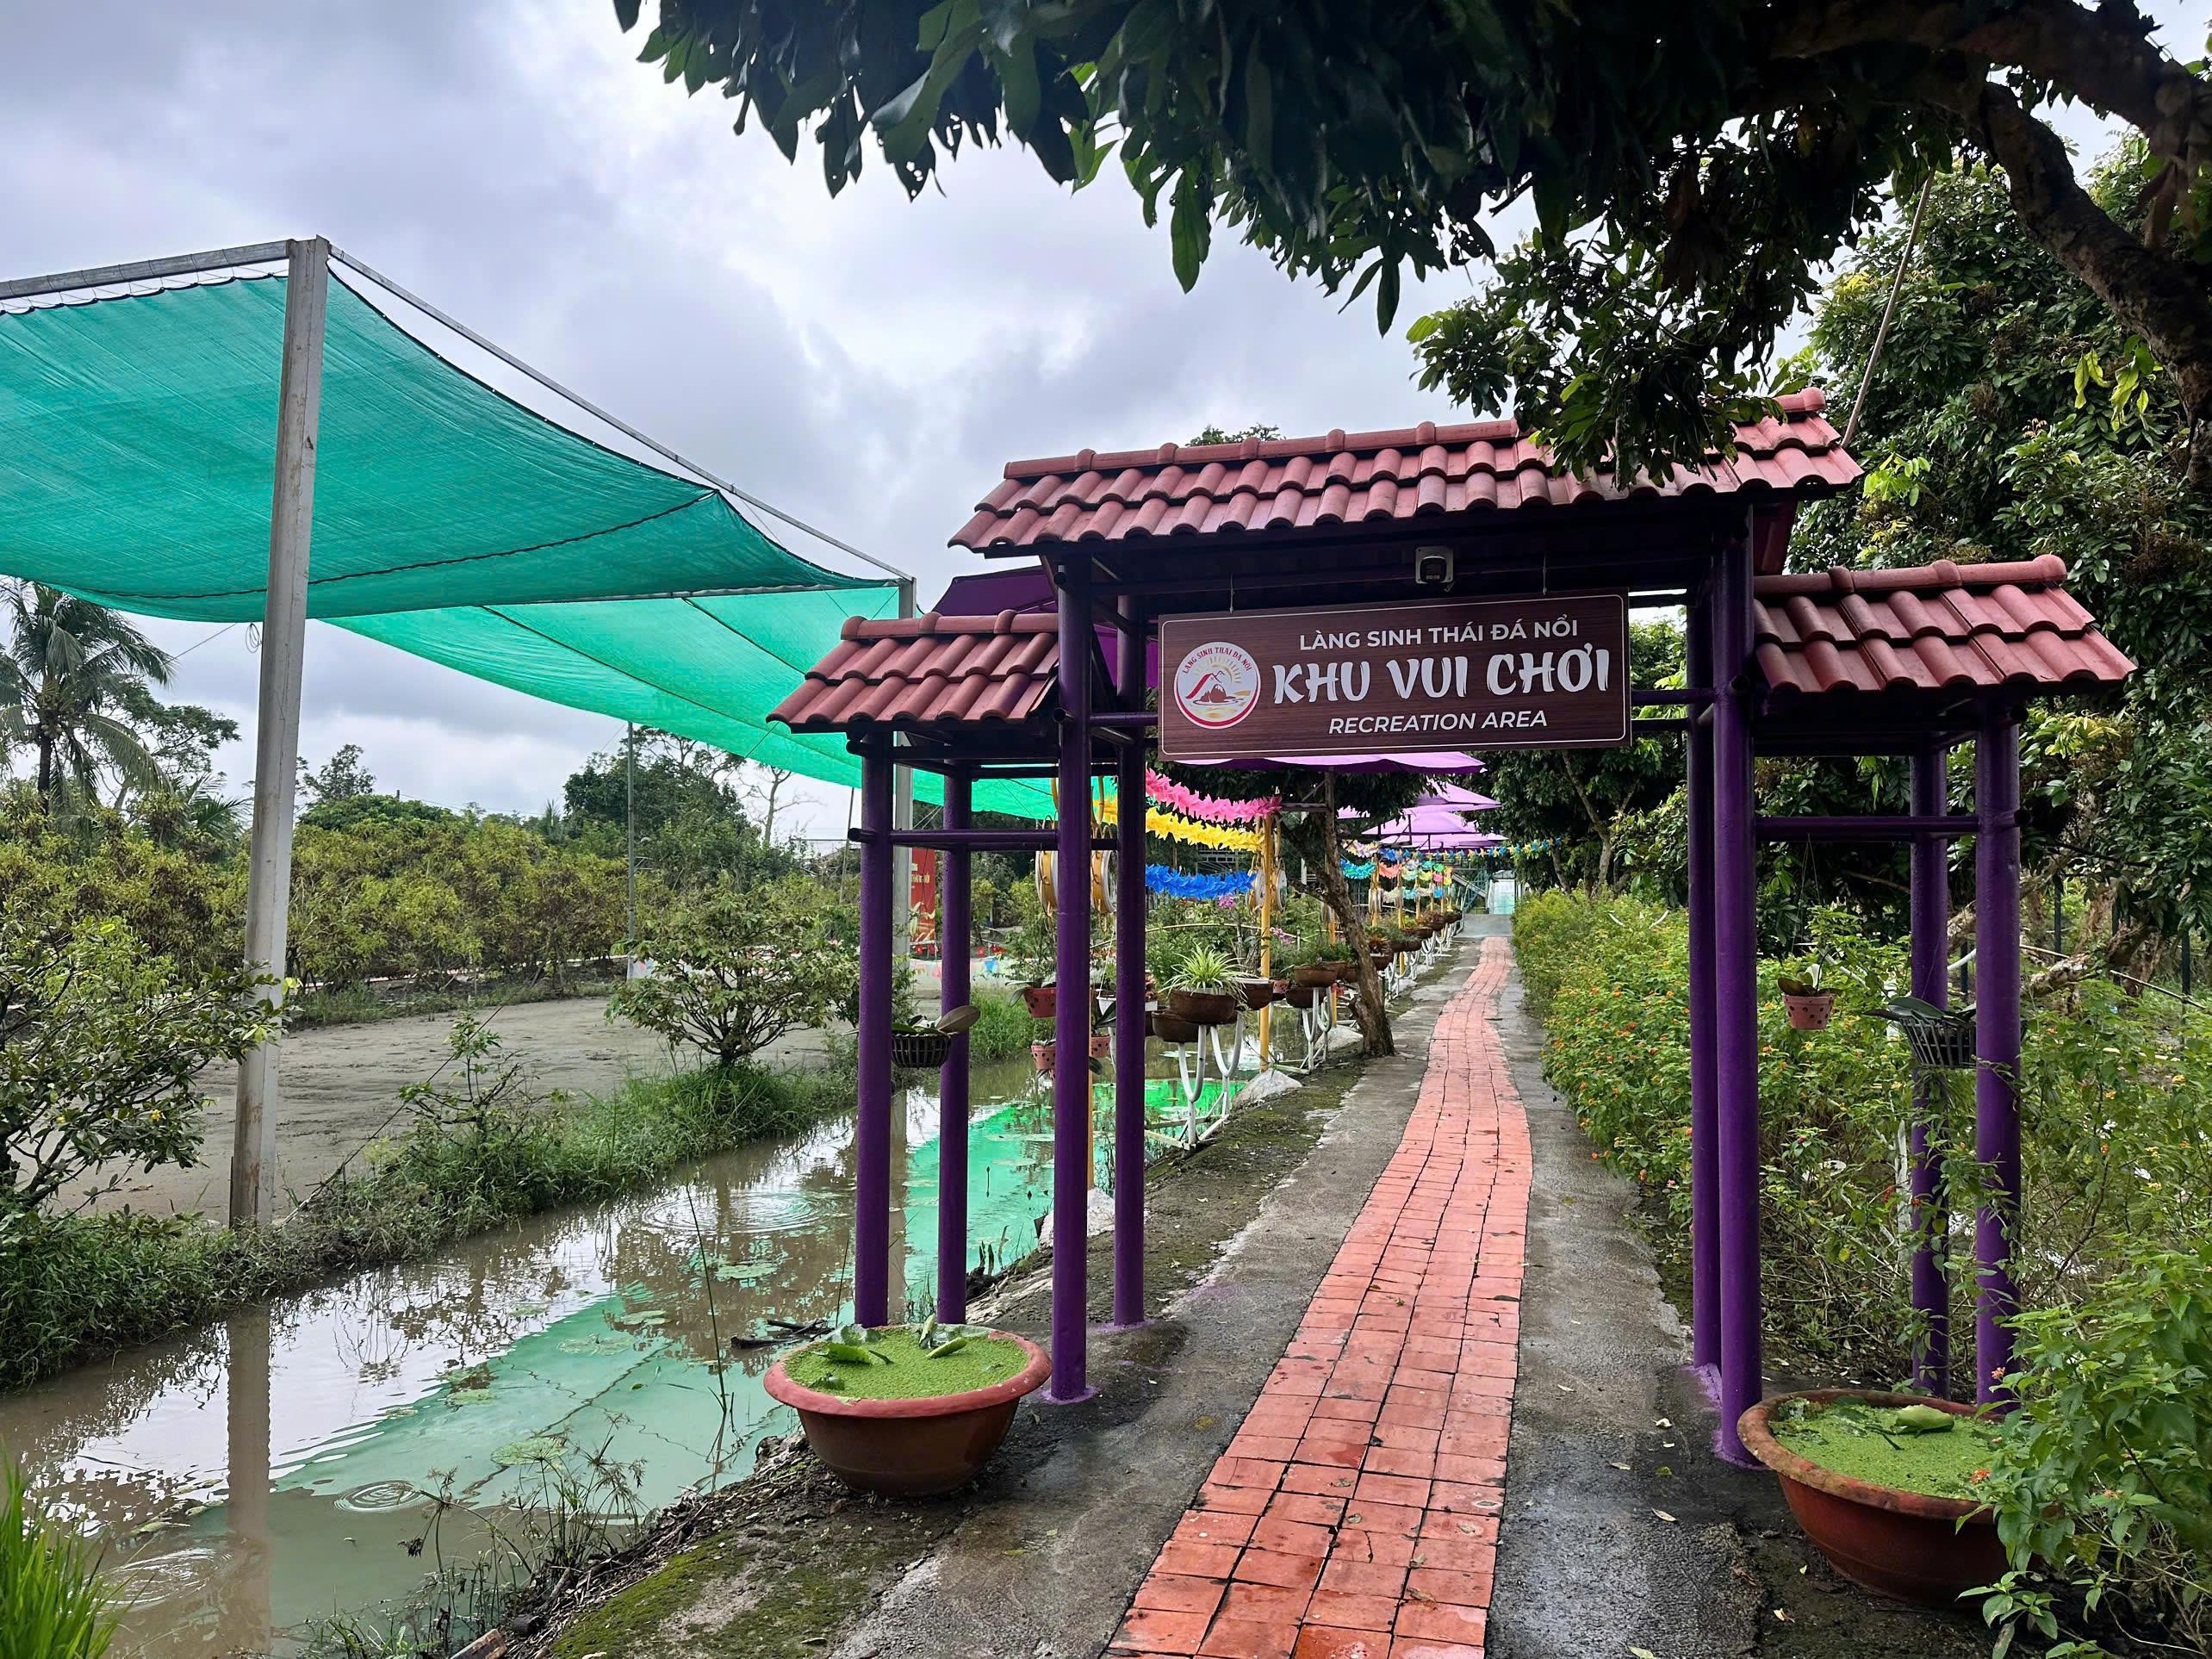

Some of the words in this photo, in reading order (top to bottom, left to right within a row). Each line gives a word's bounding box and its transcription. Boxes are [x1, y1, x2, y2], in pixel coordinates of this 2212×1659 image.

[1299, 630, 1360, 650] LÀNG
[1367, 628, 1421, 647] SINH
[1428, 621, 1483, 643] THÁI
[1490, 618, 1527, 641] ĐÁ
[1534, 613, 1578, 638] NỔI
[1197, 648, 1214, 660] SINH
[1272, 661, 1370, 705] KHU
[1386, 656, 1468, 699] VUI
[1486, 643, 1610, 696] CHƠI
[1328, 712, 1476, 735] RECREATION
[1481, 710, 1548, 729] AREA
